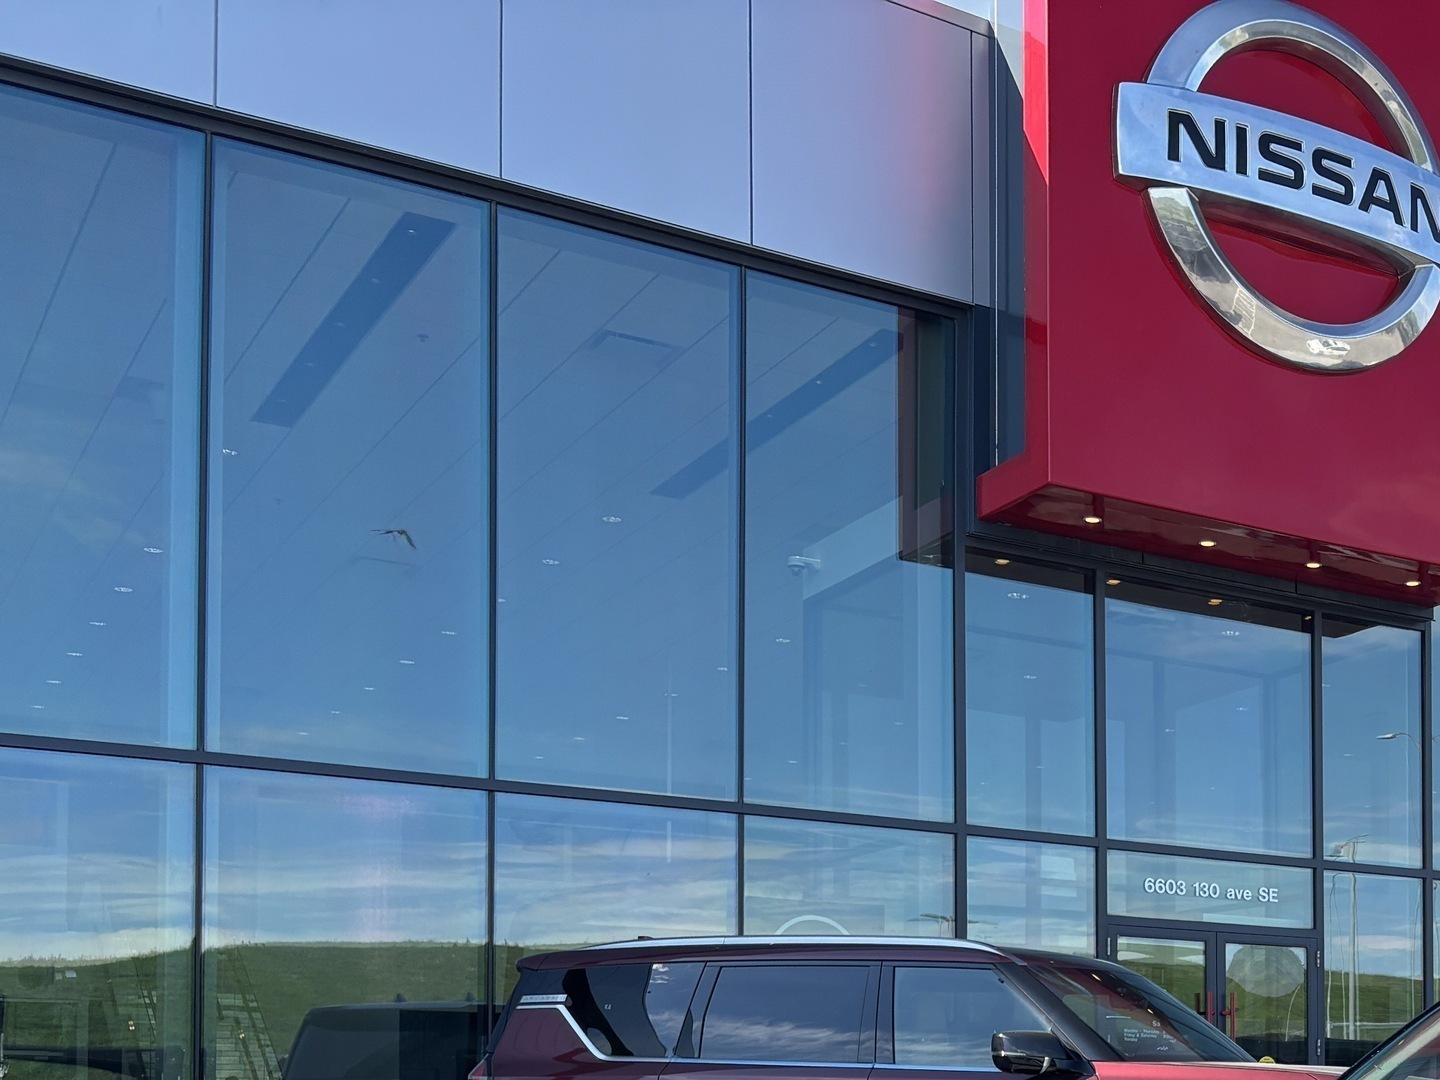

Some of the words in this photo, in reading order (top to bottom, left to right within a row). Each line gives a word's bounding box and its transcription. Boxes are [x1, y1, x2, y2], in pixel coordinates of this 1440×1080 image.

[1144, 877, 1187, 896] 6603
[1192, 881, 1220, 898] 130
[1226, 888, 1252, 901] ave
[1258, 886, 1279, 903] SE
